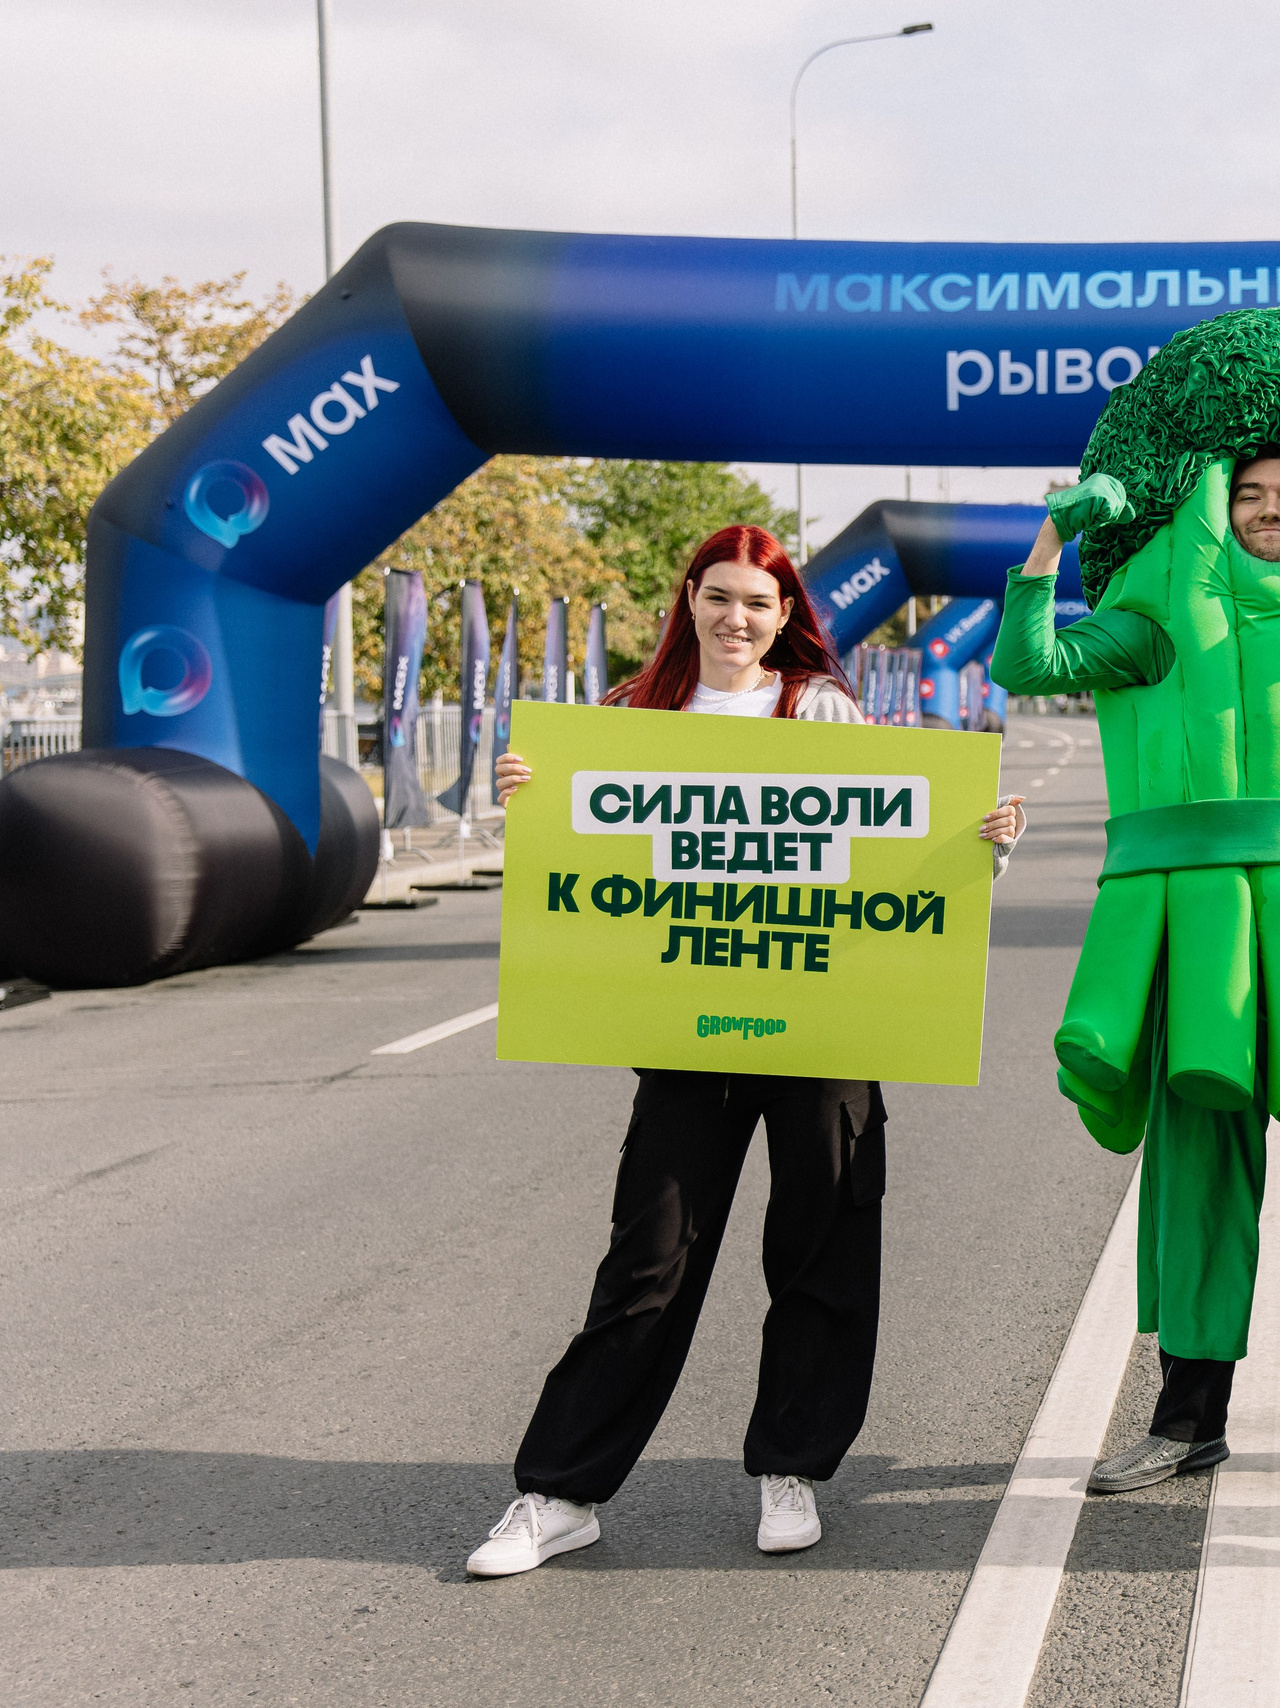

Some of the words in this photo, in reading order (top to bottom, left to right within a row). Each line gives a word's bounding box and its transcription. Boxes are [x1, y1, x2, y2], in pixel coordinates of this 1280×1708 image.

[946, 346, 1160, 411] рыво
[590, 783, 750, 825] СИЛА
[761, 786, 912, 827] ВОЛИ
[671, 830, 833, 874] ВЕДЕТ
[547, 872, 580, 913] К
[590, 873, 946, 935] ФИНИШНОЙ
[660, 924, 830, 973] ЛЕНТЕ
